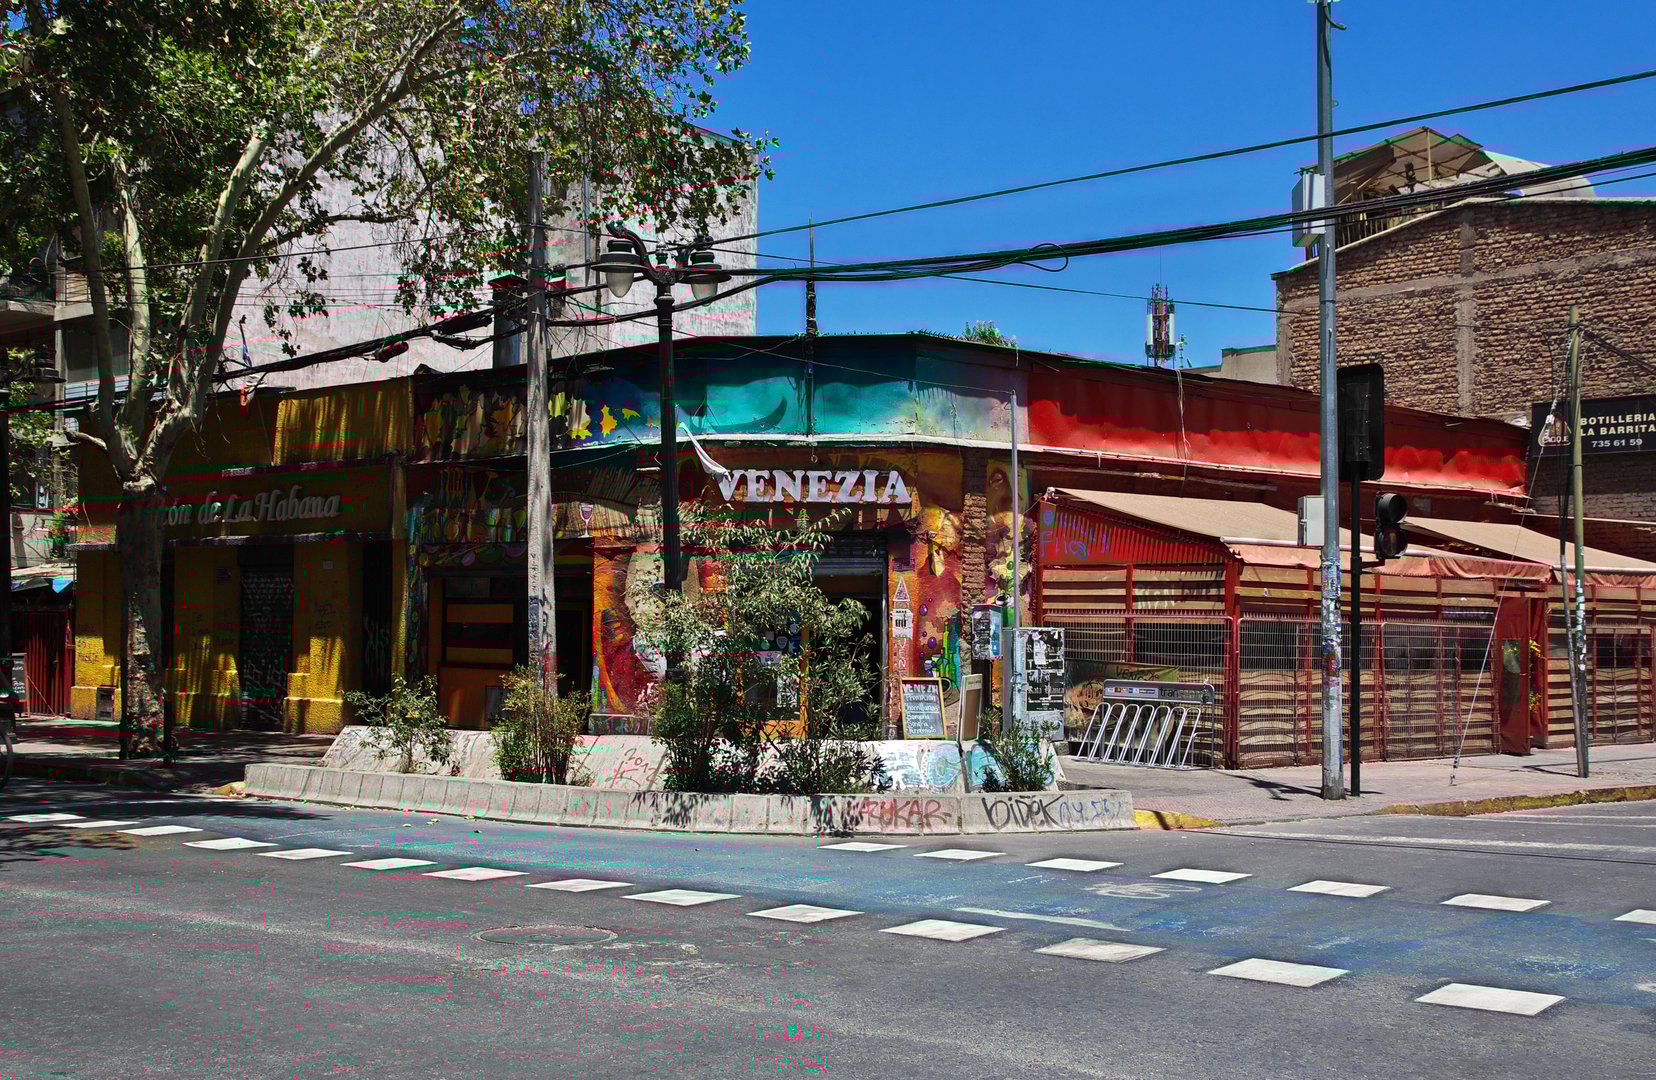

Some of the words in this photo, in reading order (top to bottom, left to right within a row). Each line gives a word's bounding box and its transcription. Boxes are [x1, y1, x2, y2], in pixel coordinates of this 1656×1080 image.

[1581, 413, 1656, 426] BOTILLERIA
[1580, 428, 1595, 437] LA
[1600, 424, 1656, 436] BARRITA
[1592, 440, 1611, 448] 735
[1613, 439, 1626, 447] 61
[1629, 438, 1643, 446] 59
[715, 469, 912, 504] VENEZIA
[198, 490, 222, 525] de
[253, 485, 341, 522] Habana
